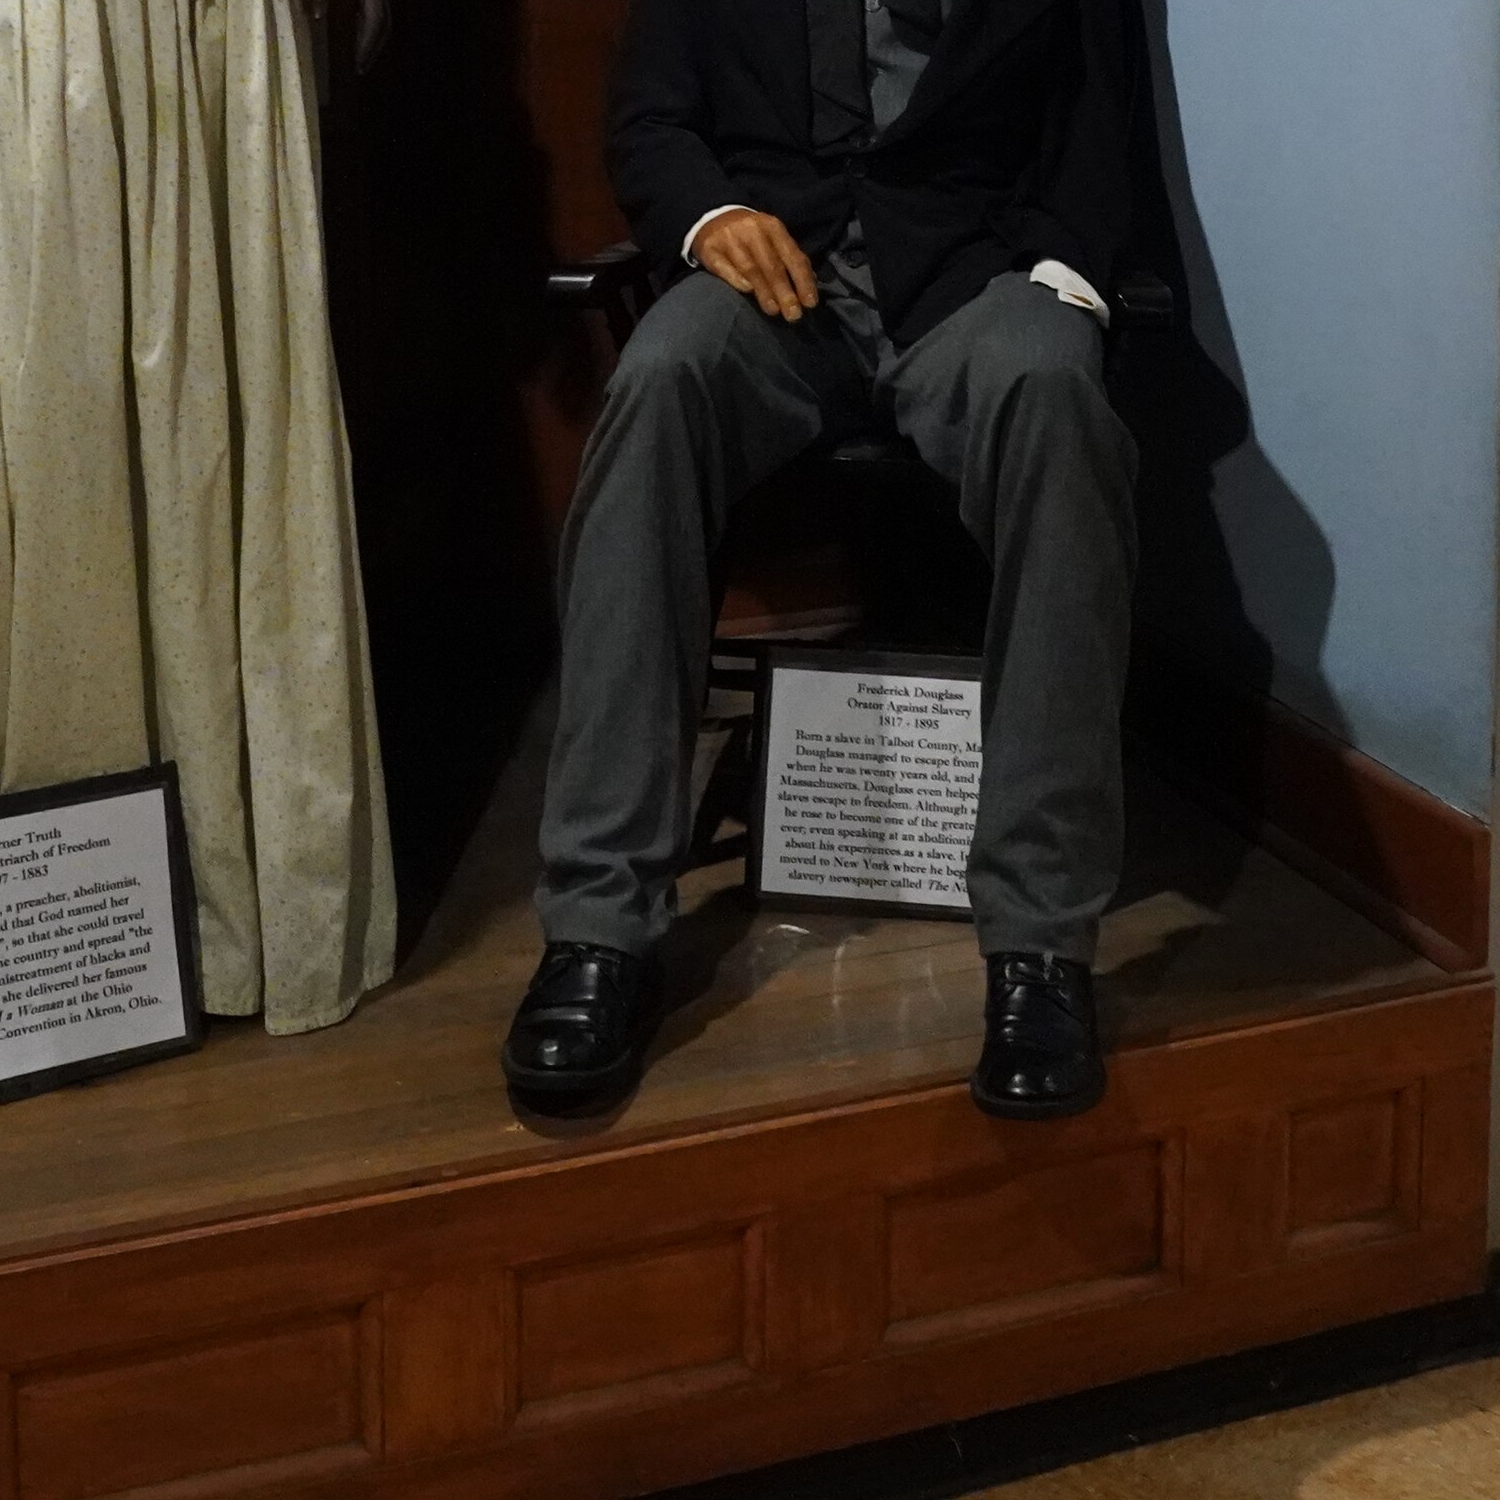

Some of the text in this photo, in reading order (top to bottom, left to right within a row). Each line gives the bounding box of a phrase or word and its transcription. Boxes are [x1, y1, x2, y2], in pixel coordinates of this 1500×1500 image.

[23, 826, 63, 845] Truth
[42, 844, 56, 859] of
[57, 837, 111, 857] Freedom
[21, 863, 49, 881] 1883
[10, 915, 36, 931] that
[37, 907, 65, 924] God
[66, 897, 108, 918] named
[109, 896, 130, 909] her
[1, 990, 23, 1005] she
[24, 974, 80, 999] delivered
[81, 972, 103, 986] her
[104, 963, 148, 981] famous
[69, 1012, 82, 1025] in
